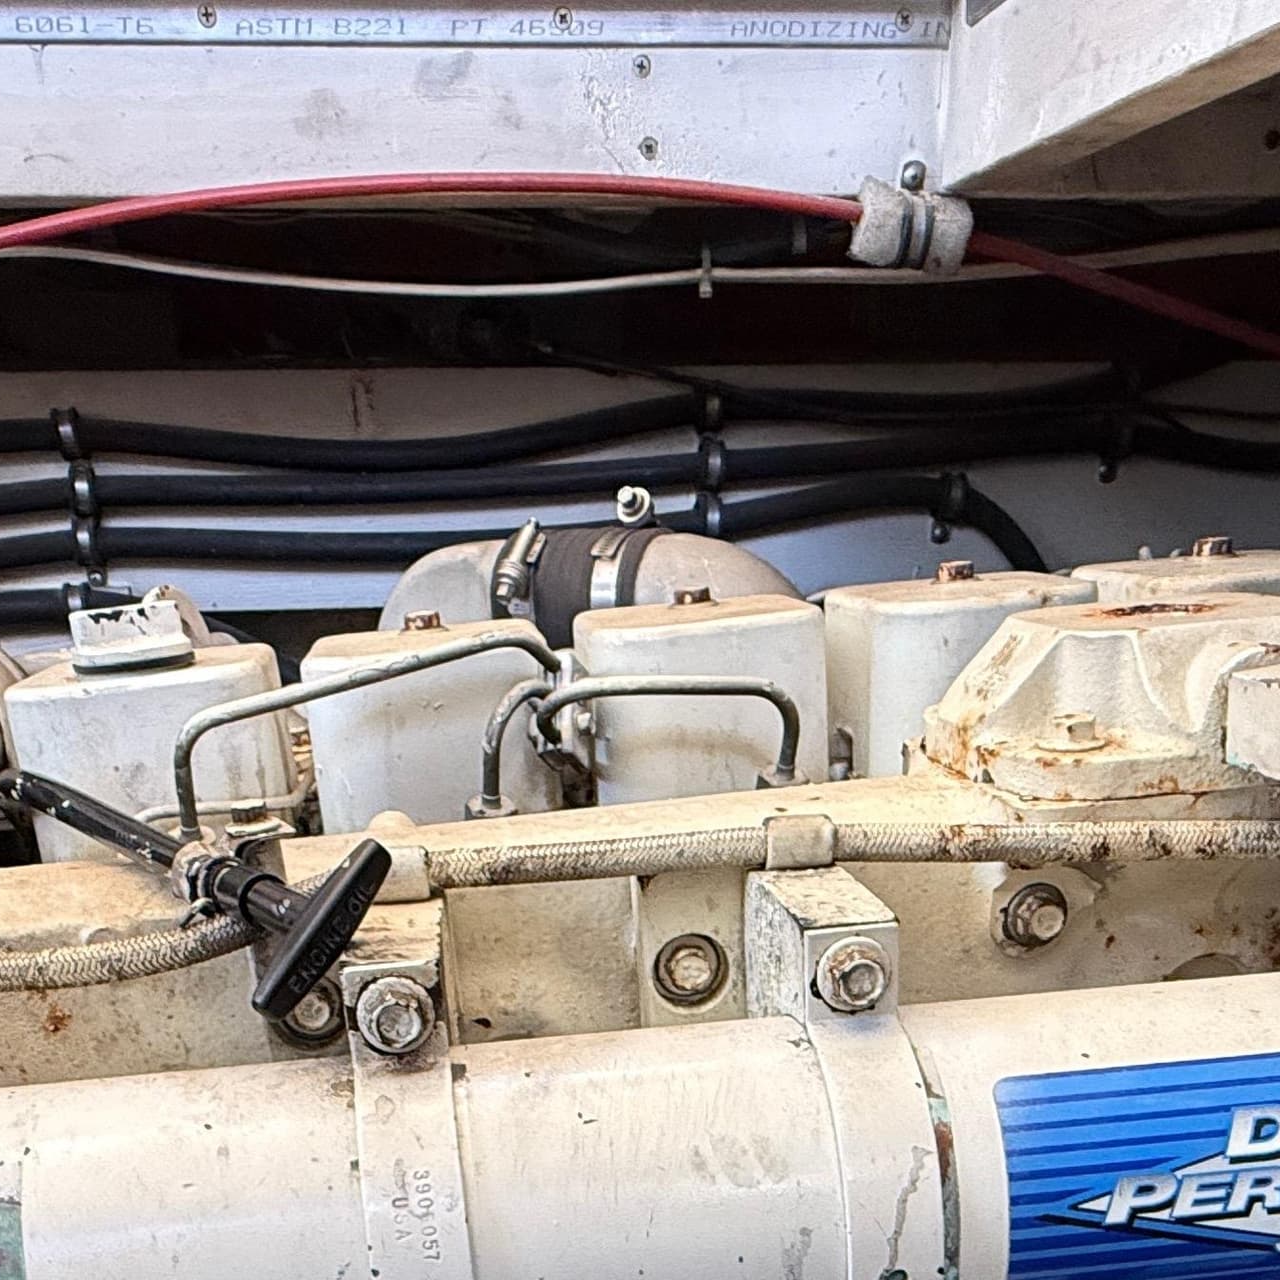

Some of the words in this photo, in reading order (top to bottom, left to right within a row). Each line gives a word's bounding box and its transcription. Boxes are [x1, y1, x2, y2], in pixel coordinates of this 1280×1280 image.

[14, 16, 155, 35] 6061-T6
[235, 17, 313, 36] ASTM
[333, 17, 407, 36] B221
[450, 18, 488, 37] PT
[730, 20, 898, 39] ANODIZING
[391, 1196, 414, 1242] USA
